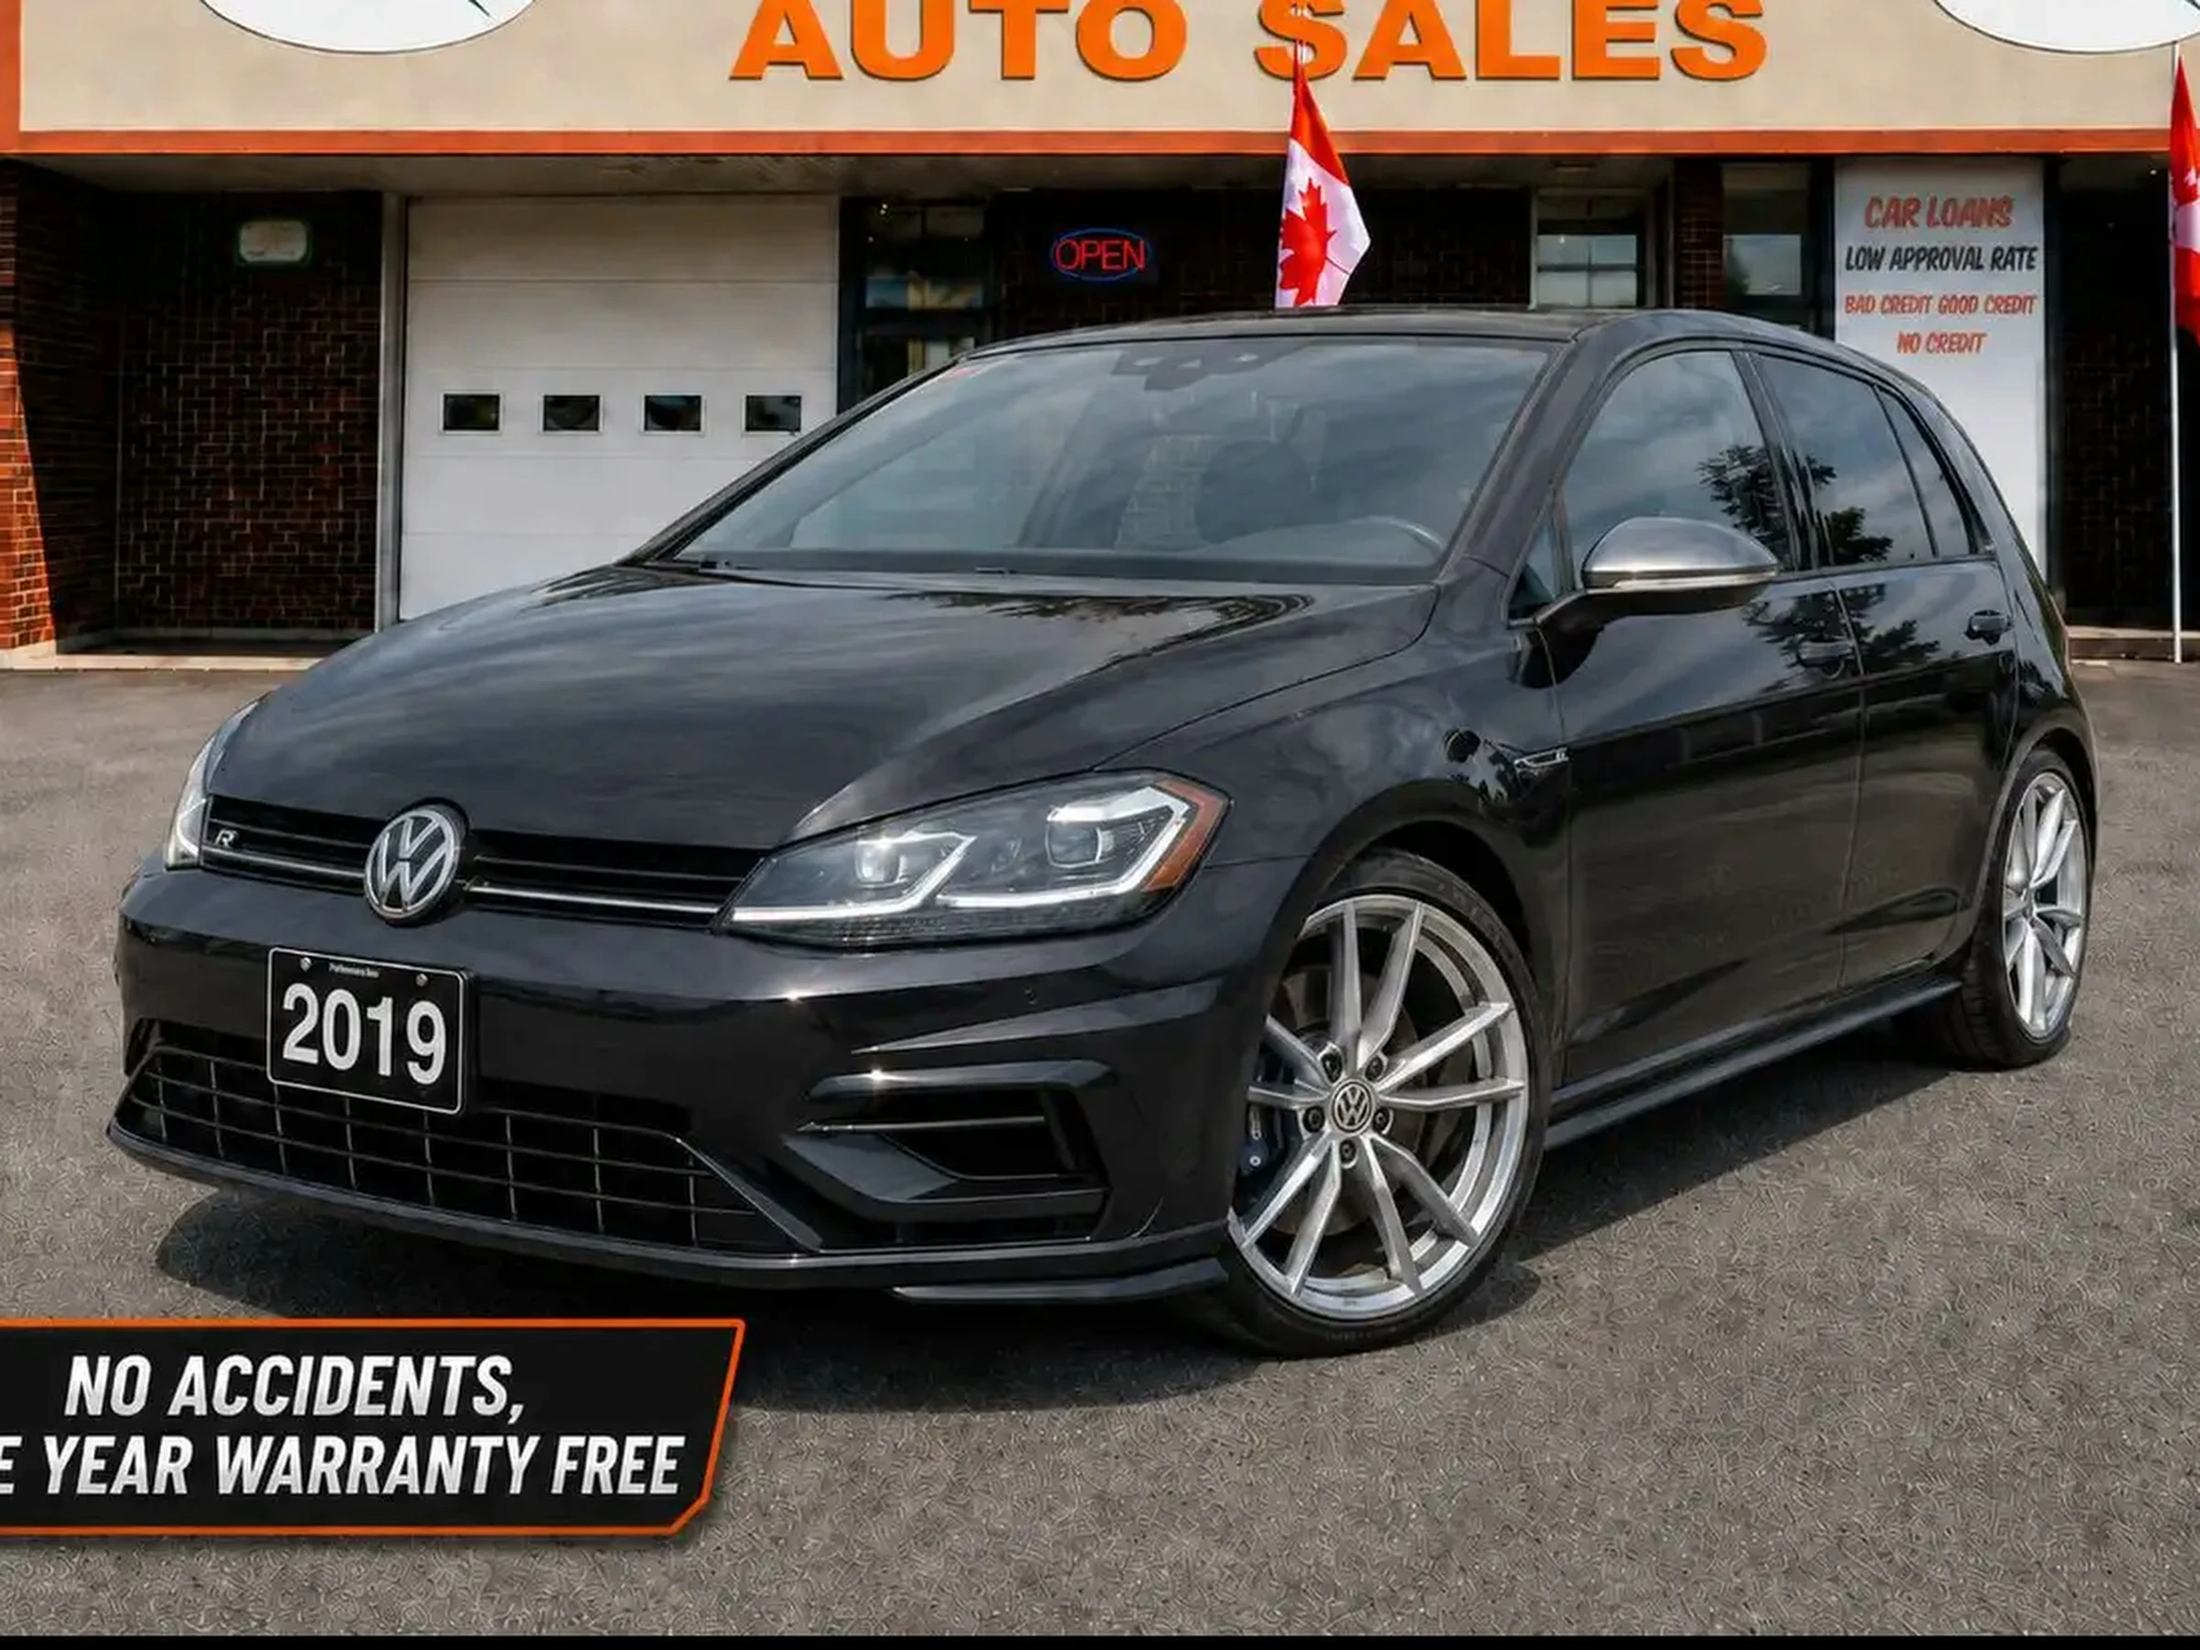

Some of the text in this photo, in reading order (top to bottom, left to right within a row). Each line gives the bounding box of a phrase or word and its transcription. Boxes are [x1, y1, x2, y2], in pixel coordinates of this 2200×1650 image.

[729, 0, 1768, 82] AUTO SALES
[1864, 194, 2014, 228] CAR LOANS
[1055, 239, 1145, 270] OPEN
[1845, 245, 2039, 271] LOW APPROVAL RATE
[1845, 294, 2036, 315] BAD CREDIT GOOD CREDIT
[1896, 331, 1987, 354] NO CREDIT
[214, 829, 239, 849] R
[282, 982, 447, 1085] 2019
